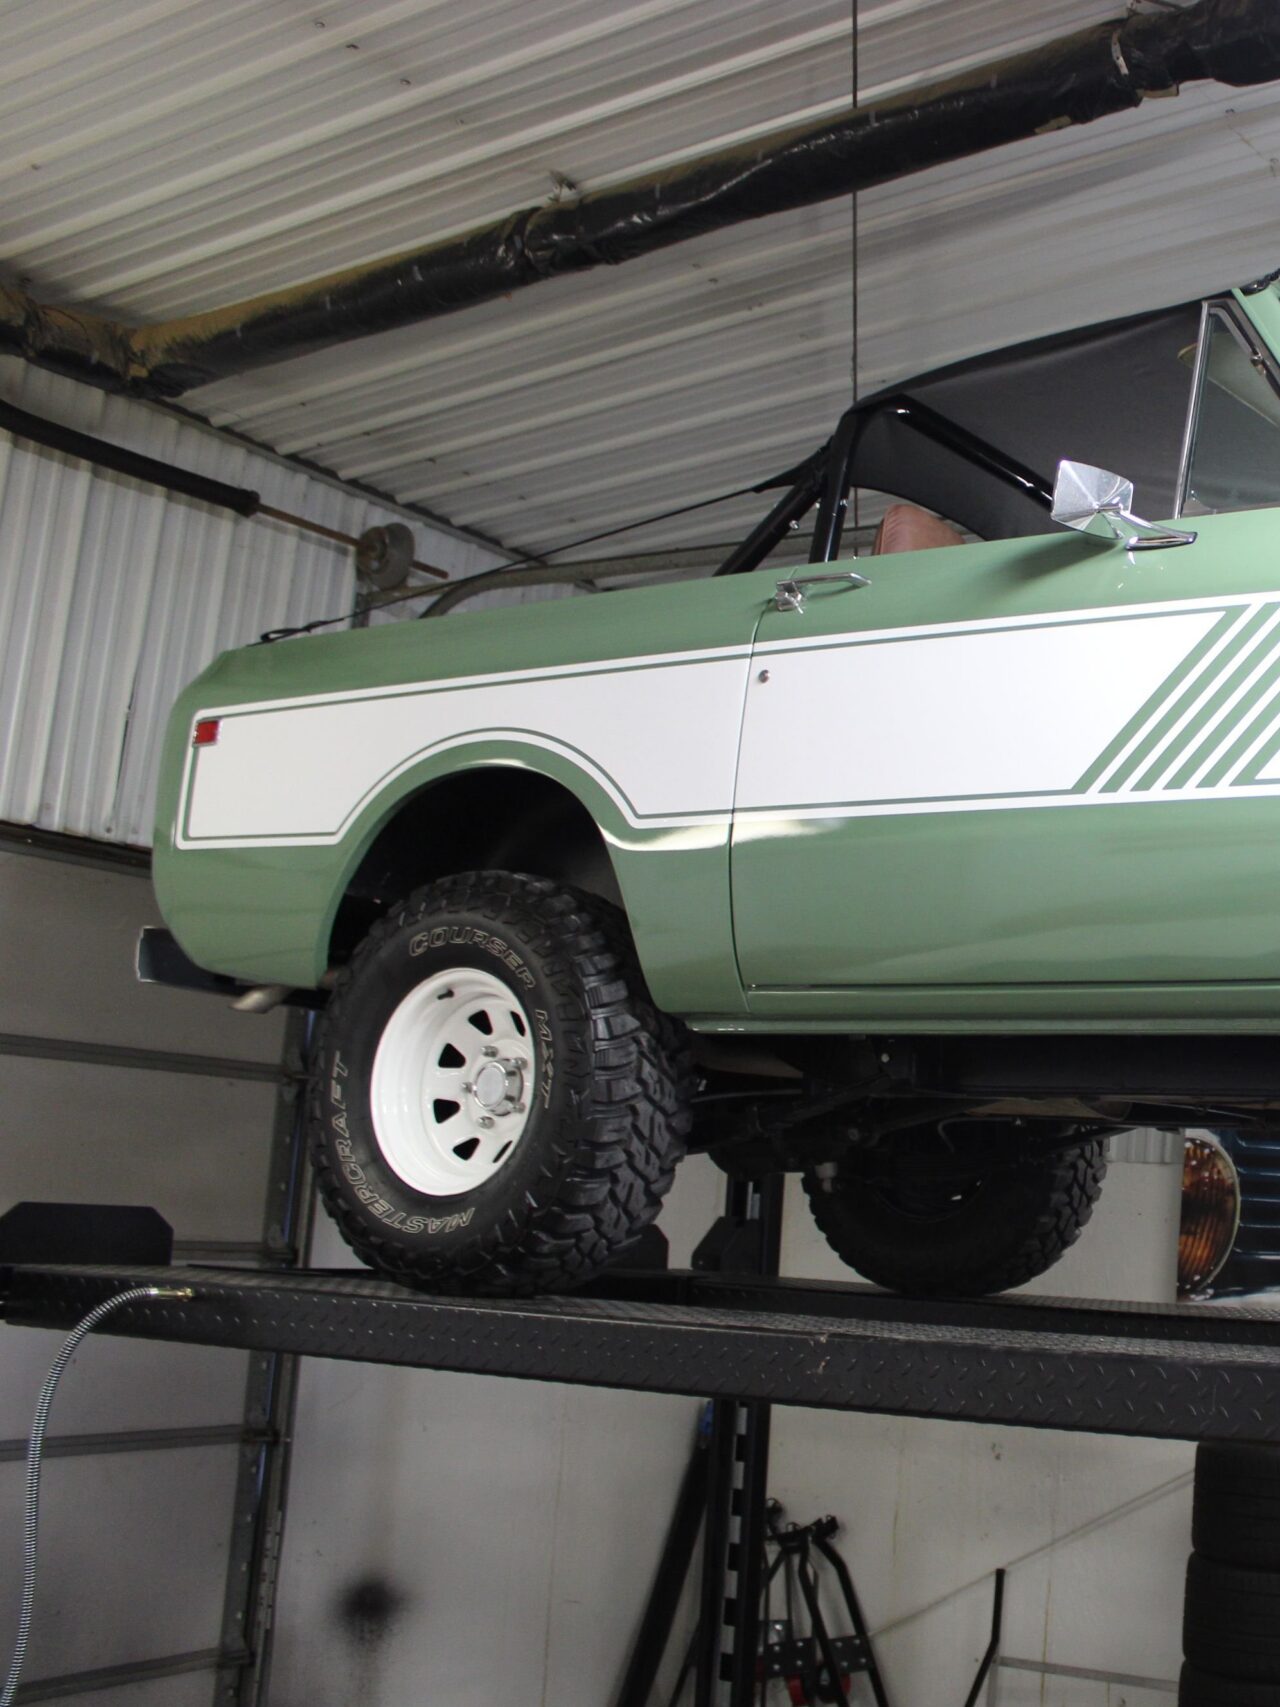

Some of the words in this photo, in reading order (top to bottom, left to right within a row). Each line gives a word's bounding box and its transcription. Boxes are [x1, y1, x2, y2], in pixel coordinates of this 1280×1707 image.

[409, 926, 536, 991] COURSER
[534, 1008, 554, 1110] MXT
[330, 1050, 476, 1235] MASTERCRAFT
